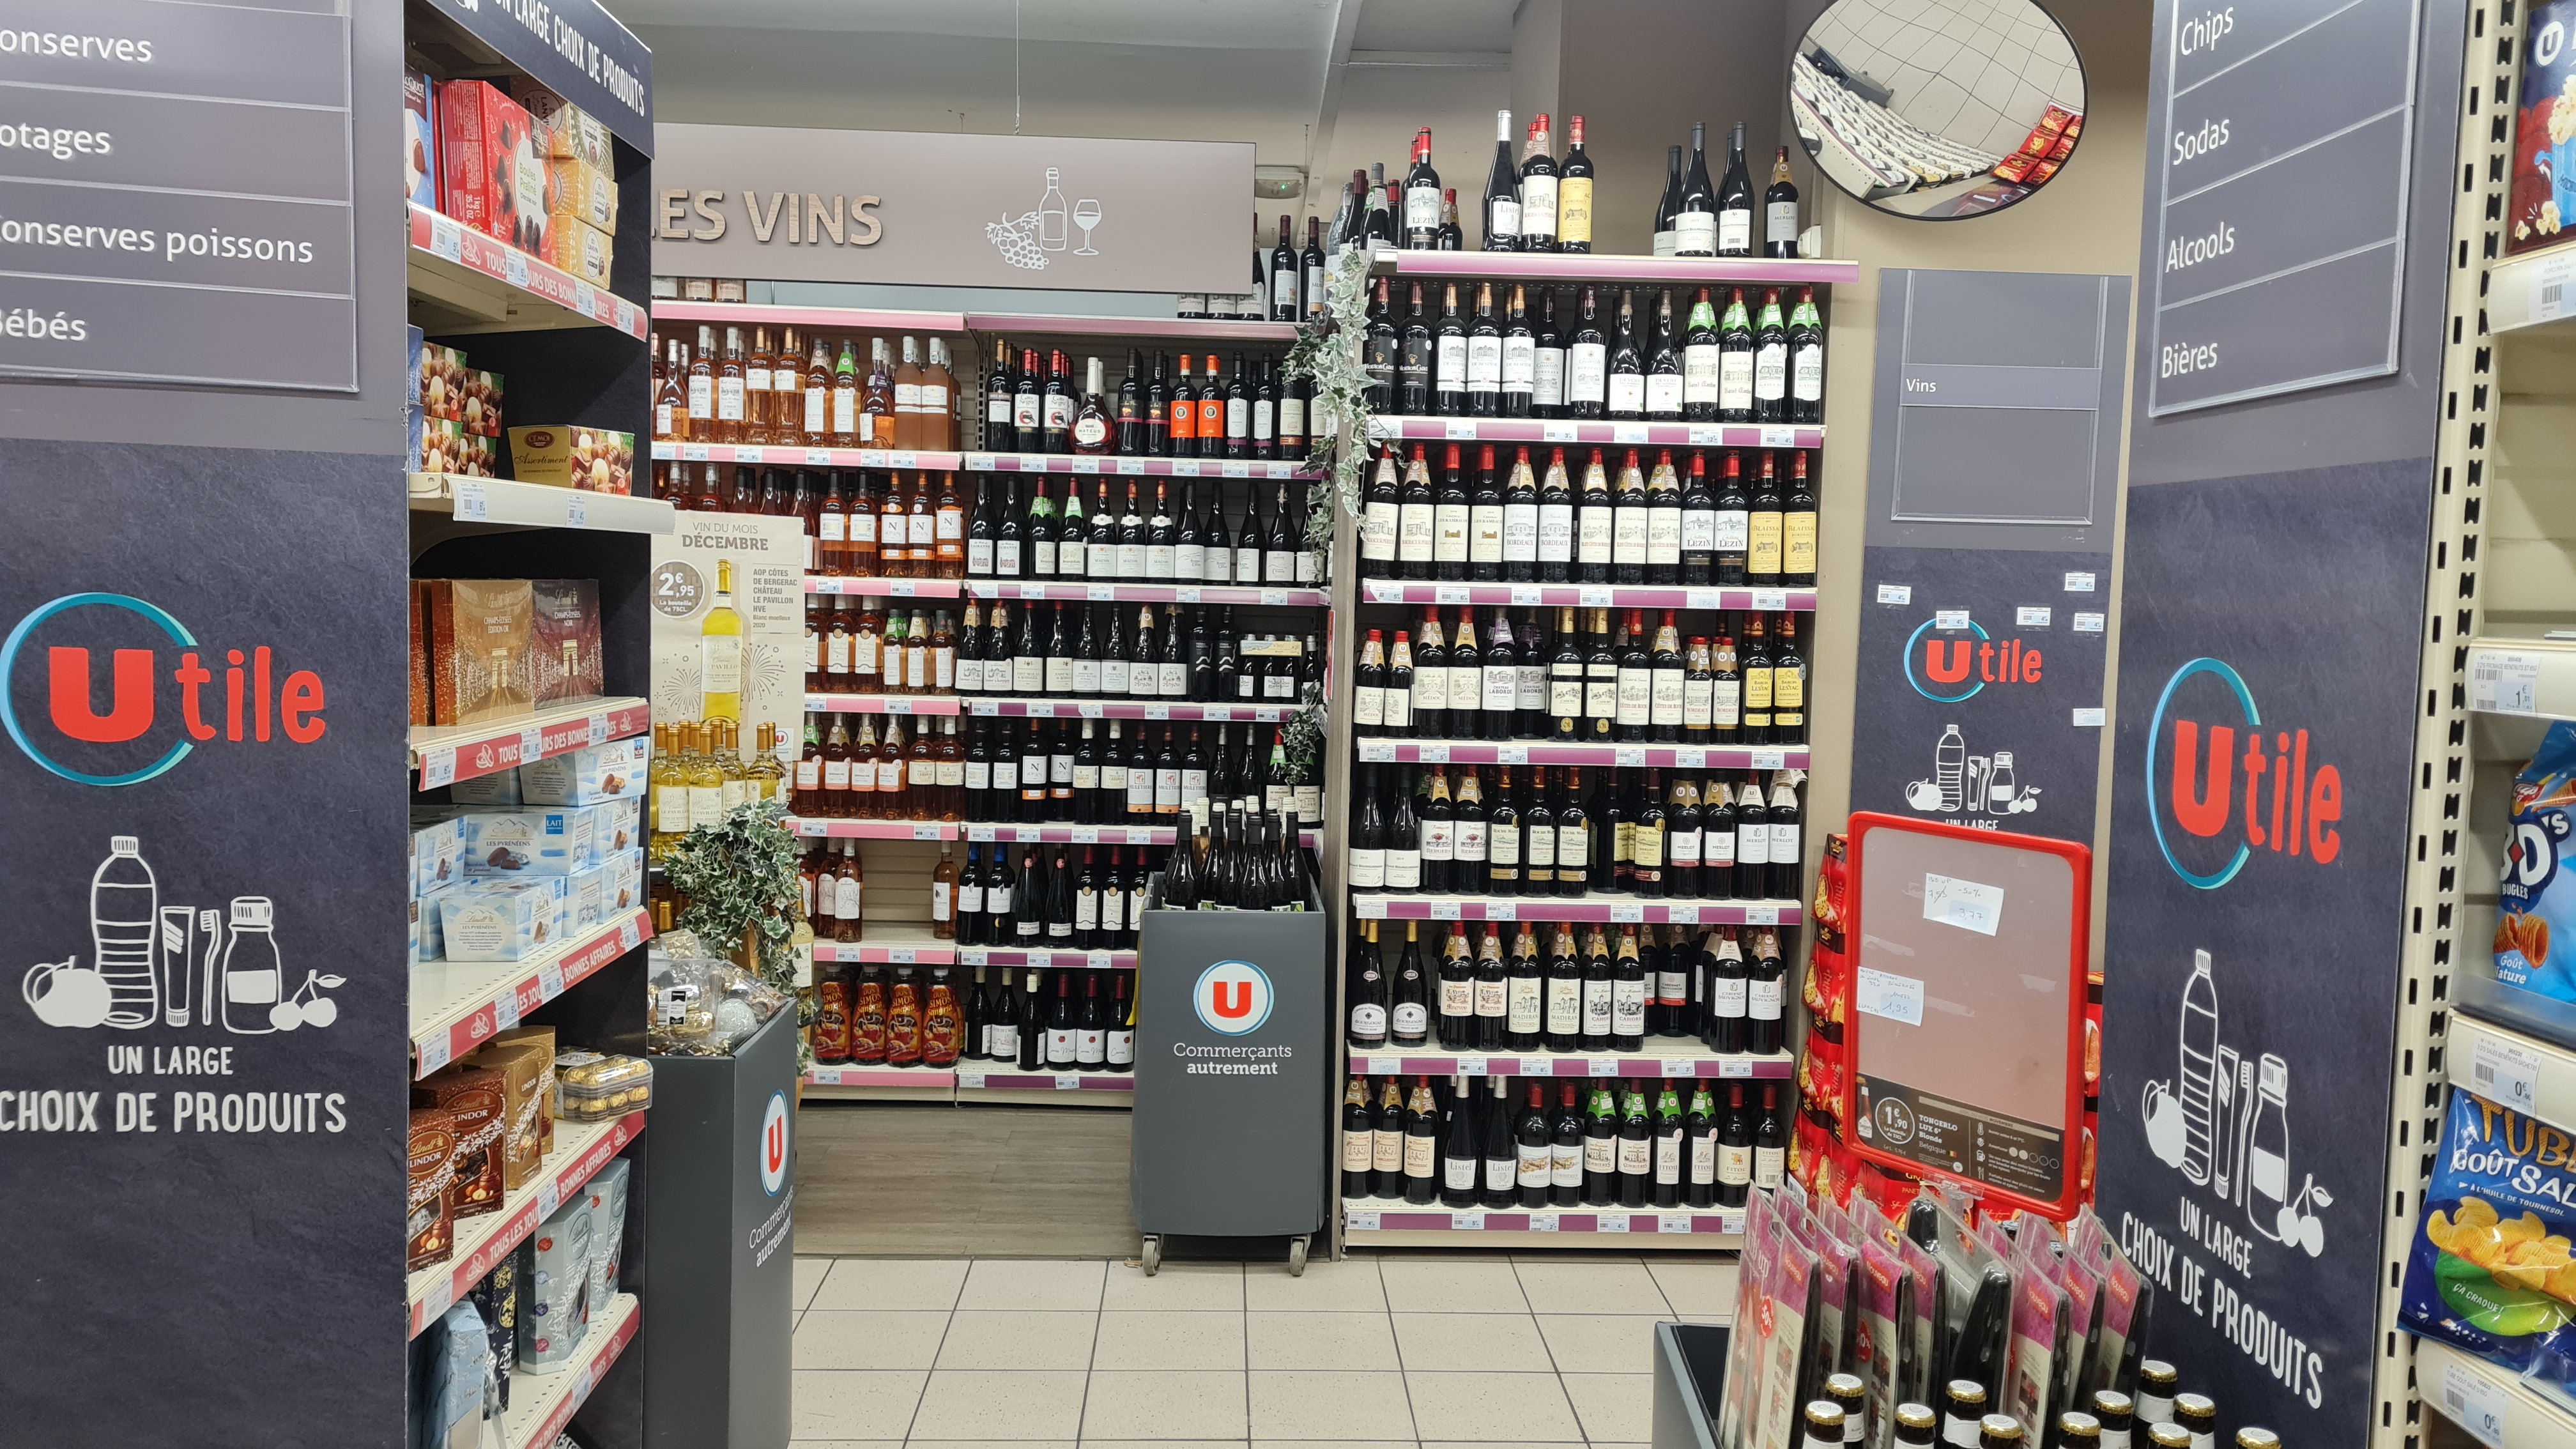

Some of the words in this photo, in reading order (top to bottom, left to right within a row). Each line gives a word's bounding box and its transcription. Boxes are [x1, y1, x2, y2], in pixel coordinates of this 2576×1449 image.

[2181, 6, 2234, 56] Chips
[2542, 31, 2559, 57] U
[0, 29, 153, 63] onserves
[516, 0, 550, 44] LARGE
[555, 14, 585, 71] CHOIX
[588, 41, 600, 84] DE
[602, 54, 645, 117] PRODUITS
[0, 121, 112, 160] otages
[2173, 119, 2230, 166] Sodas
[519, 163, 535, 181] Boules
[652, 188, 726, 241] ES
[742, 190, 883, 246] VINS
[1412, 215, 1436, 225] LEZIN
[0, 215, 155, 252] onserves
[166, 227, 313, 263] poissons
[2166, 221, 2235, 273] Alcools
[486, 252, 506, 275] TOUS
[543, 277, 558, 296] DES
[0, 308, 86, 342] ébés
[2162, 341, 2218, 378] Bières
[1906, 378, 1936, 394] Vins
[514, 454, 568, 466] Assortiment
[682, 532, 768, 551] DÉCEMBRE
[693, 522, 710, 532] VIN
[714, 523, 729, 532] DU
[732, 525, 758, 534] MOIS
[768, 568, 788, 577] CÔTES
[753, 586, 783, 595] CHÂTEAU
[1926, 638, 2042, 683] Utile
[49, 646, 326, 743] Utile
[498, 745, 518, 764] TOUS
[554, 737, 567, 753] DES
[2173, 719, 2342, 864] Utile
[2503, 884, 2528, 900] BUGLES
[1959, 908, 1983, 920] 3,77
[564, 958, 590, 983] BONNES
[589, 940, 617, 967] AFFAIRES
[2500, 955, 2523, 970] Goût
[859, 993, 881, 1005] SIMON
[893, 995, 914, 1007] SIMON
[928, 1004, 953, 1016] Sangria
[929, 995, 951, 1008] SIMON
[1213, 981, 1252, 1018] U
[1883, 1002, 1908, 1013] 1,95
[107, 1046, 142, 1075] UN
[154, 1046, 233, 1075] LARGE
[1174, 1043, 1292, 1061] Commerçants
[1187, 1062, 1278, 1075] autrement
[0, 1090, 100, 1133] CHOIX
[116, 1092, 158, 1133] DE
[174, 1092, 346, 1133] PRODUITS
[1919, 1114, 1958, 1131] TONGERLO
[1919, 1124, 1933, 1133] LUX
[1919, 1131, 1942, 1144] Blonde
[769, 1114, 782, 1174] U
[1919, 1140, 1946, 1155] Belgique
[410, 1151, 441, 1168] LINDOR
[1450, 1162, 1471, 1171] Listel
[1492, 1163, 1513, 1172] Listel
[2449, 1149, 2519, 1177] GOÛT
[2511, 1165, 2576, 1208] SAL
[489, 1236, 511, 1263] TOUS
[511, 1222, 524, 1243] LES
[560, 1166, 585, 1197] BONNES
[585, 1141, 611, 1174] AFFAIRES
[2476, 1186, 2505, 1199] L'HUILE
[2519, 1198, 2564, 1217] TOURNESOL
[749, 1185, 793, 1250] Commerçants
[756, 1211, 790, 1268] autrement
[2181, 1196, 2200, 1241] UN
[2205, 1214, 2253, 1278] LARGE
[2122, 1212, 2174, 1292] CHOIX
[2181, 1255, 2205, 1317] DE
[2212, 1278, 2323, 1409] PRODUITS
[2453, 1284, 2465, 1295] ÇA
[2466, 1291, 2499, 1313] CRAQUE
